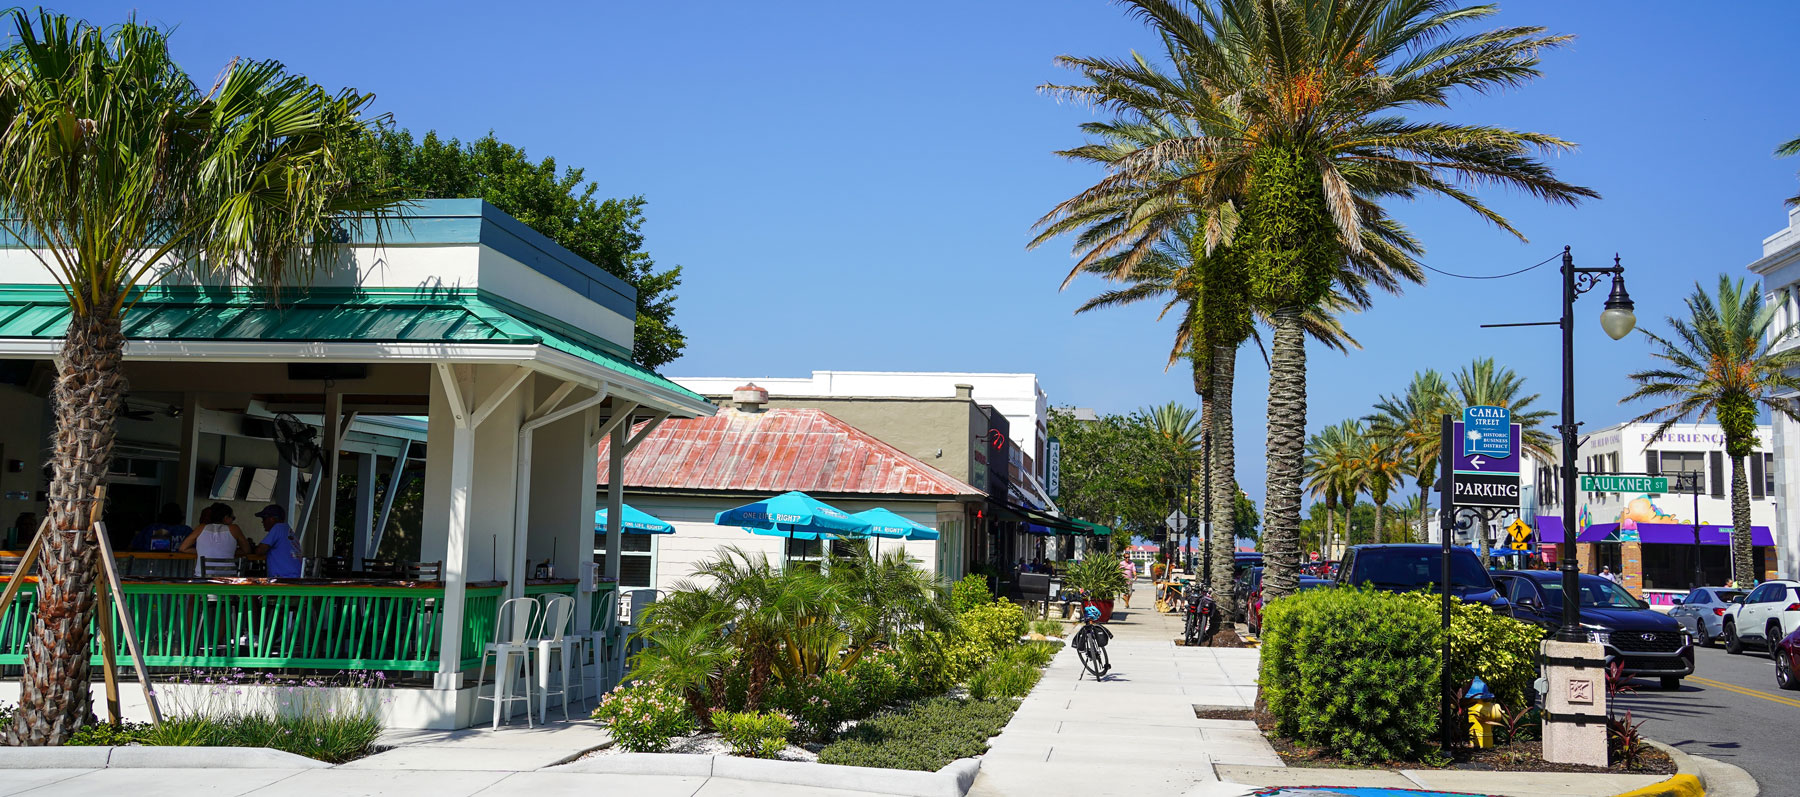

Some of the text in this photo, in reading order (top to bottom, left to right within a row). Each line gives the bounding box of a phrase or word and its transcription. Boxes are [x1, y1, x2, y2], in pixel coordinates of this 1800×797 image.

[1469, 408, 1505, 418] CANAL
[1455, 483, 1518, 497] PARKING
[1585, 478, 1664, 491] FAULKNER ST
[742, 512, 757, 520] ONE
[776, 513, 801, 523] RIGHT?
